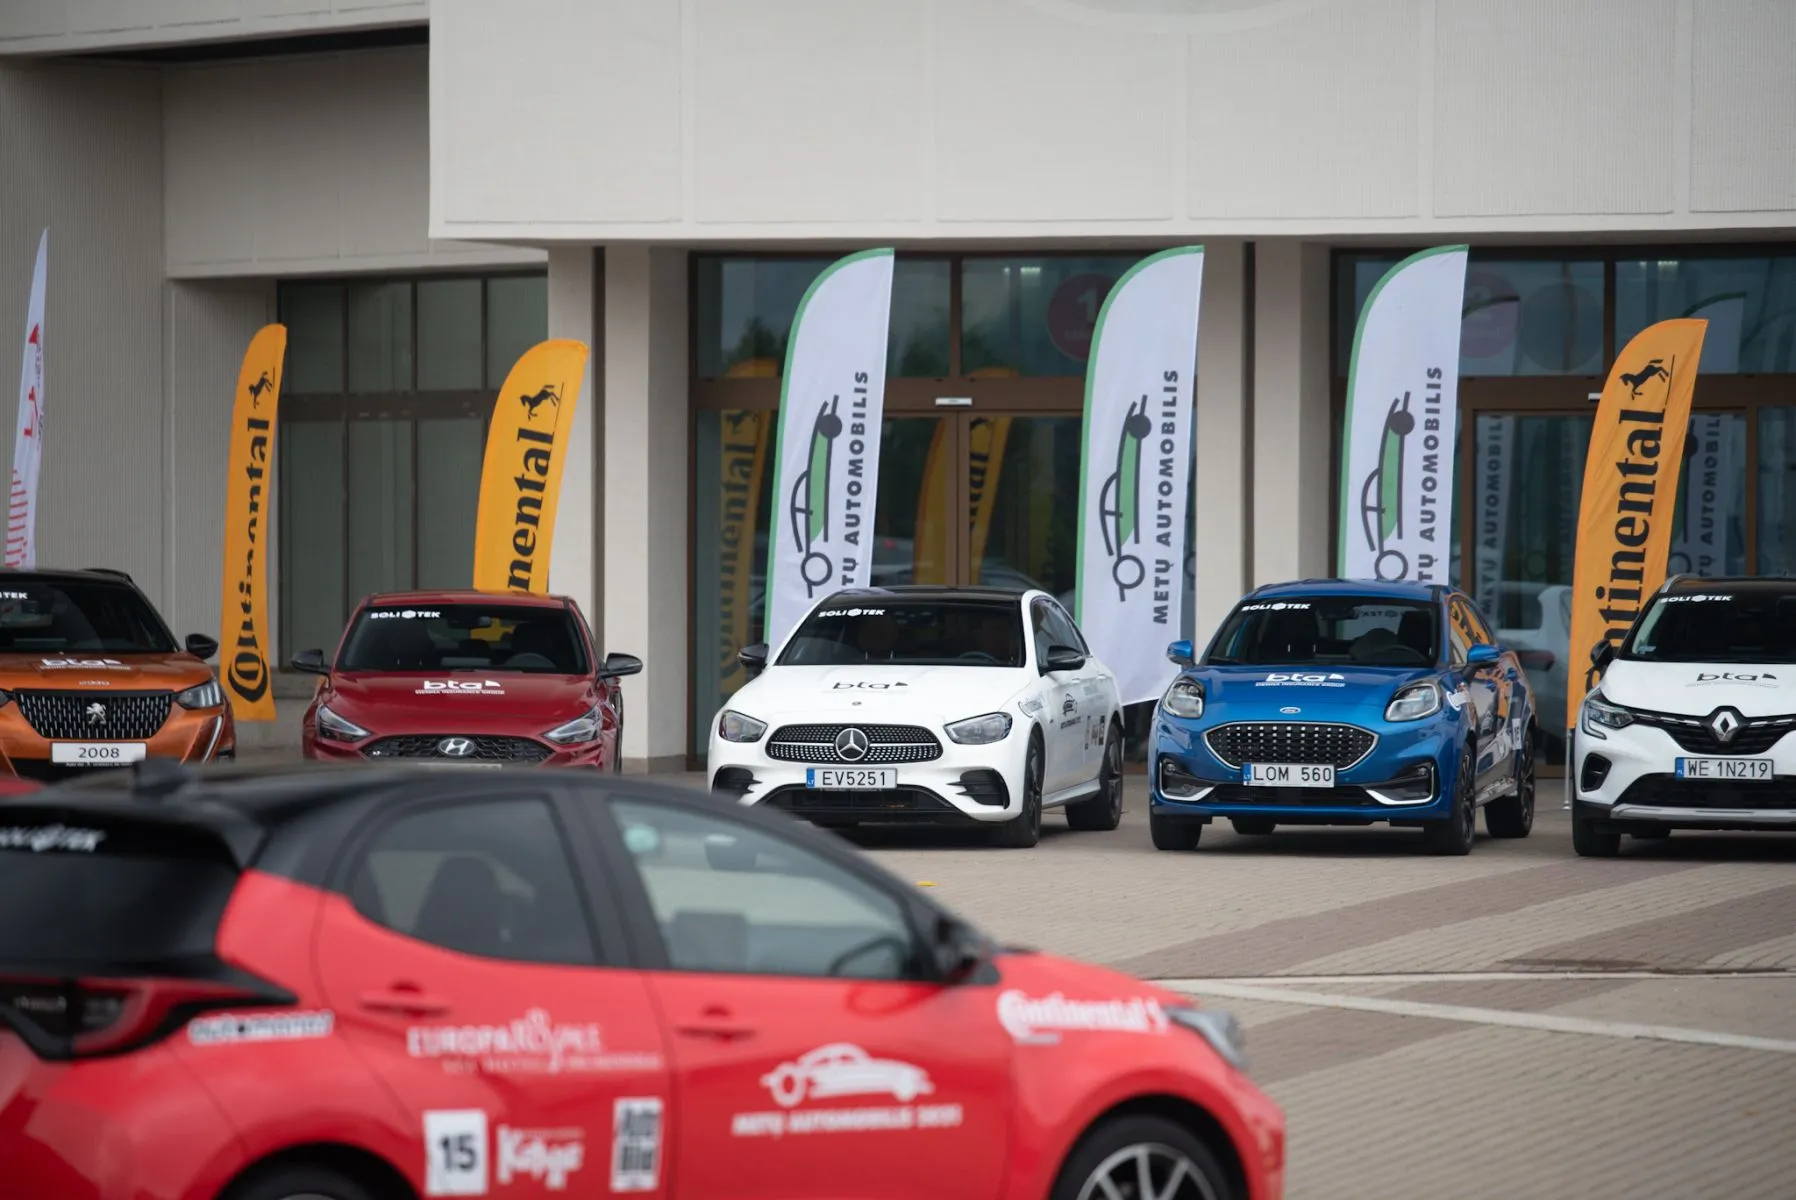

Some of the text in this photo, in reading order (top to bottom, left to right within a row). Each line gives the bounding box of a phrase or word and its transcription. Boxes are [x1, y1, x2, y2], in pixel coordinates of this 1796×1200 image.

[845, 371, 868, 546] AUTOMOBILIS
[1420, 366, 1442, 541] AUTOMOBILIS
[1153, 370, 1178, 624] METŲ AUTOMOBILIS
[1585, 408, 1665, 693] ntinental
[424, 680, 483, 690] bta
[1266, 673, 1327, 682] bta
[1696, 672, 1758, 682] bta
[832, 681, 891, 690] bta
[78, 747, 120, 759] 2008
[1253, 766, 1290, 781] LOM
[1301, 767, 1333, 782] 560
[1687, 761, 1709, 777] WE
[1717, 761, 1769, 778] 1N219
[822, 771, 886, 786] EV5251
[440, 1131, 477, 1173] 15
